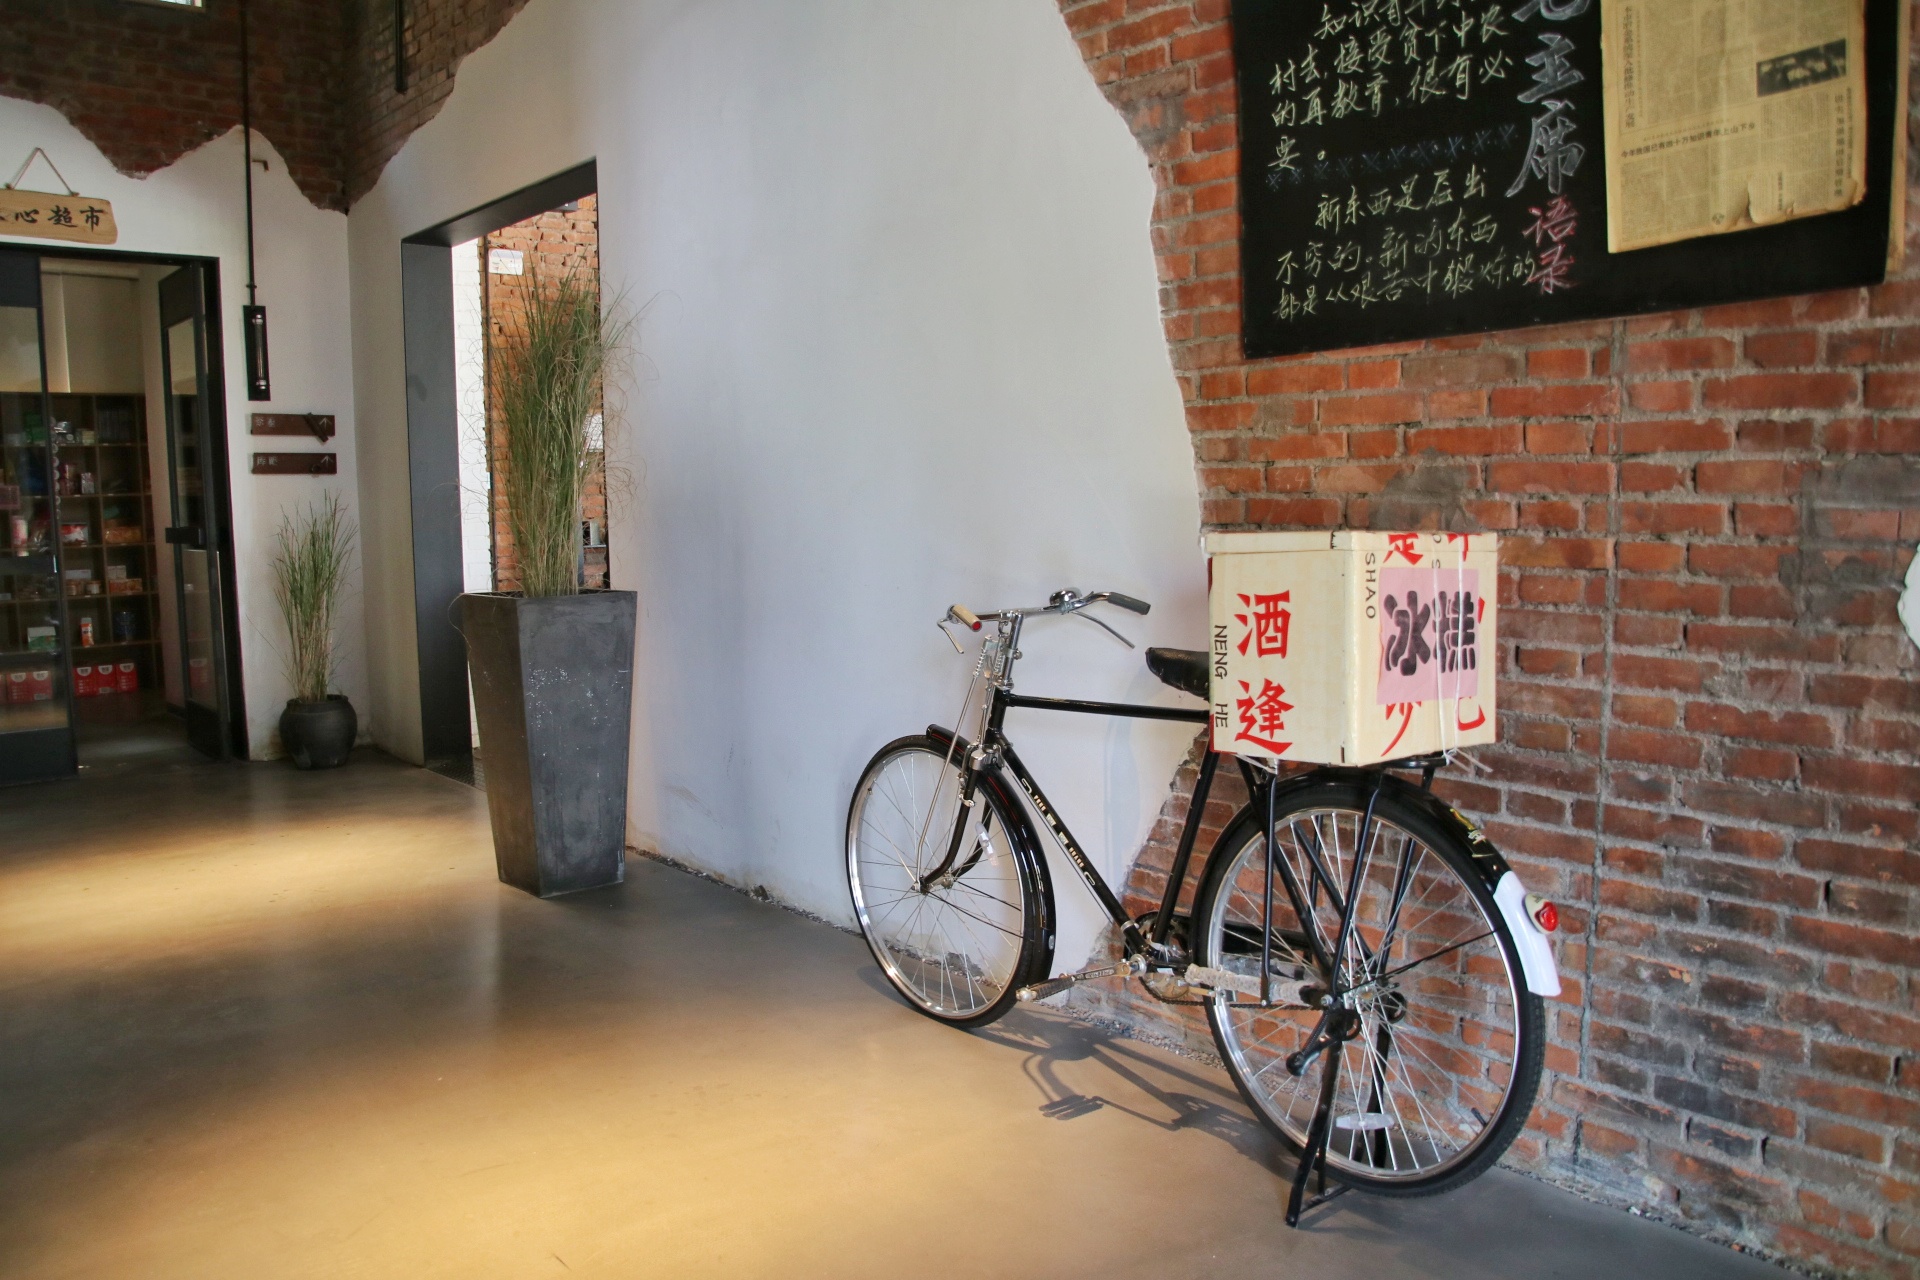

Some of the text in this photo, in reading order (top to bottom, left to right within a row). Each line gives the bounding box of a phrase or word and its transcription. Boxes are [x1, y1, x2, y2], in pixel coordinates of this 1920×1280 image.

[0, 205, 106, 232] 心超市
[1365, 552, 1376, 620] SHAO
[1213, 624, 1228, 728] NENG HE
[1234, 589, 1294, 755] 酒逢
[1383, 590, 1476, 676] 冰糕
